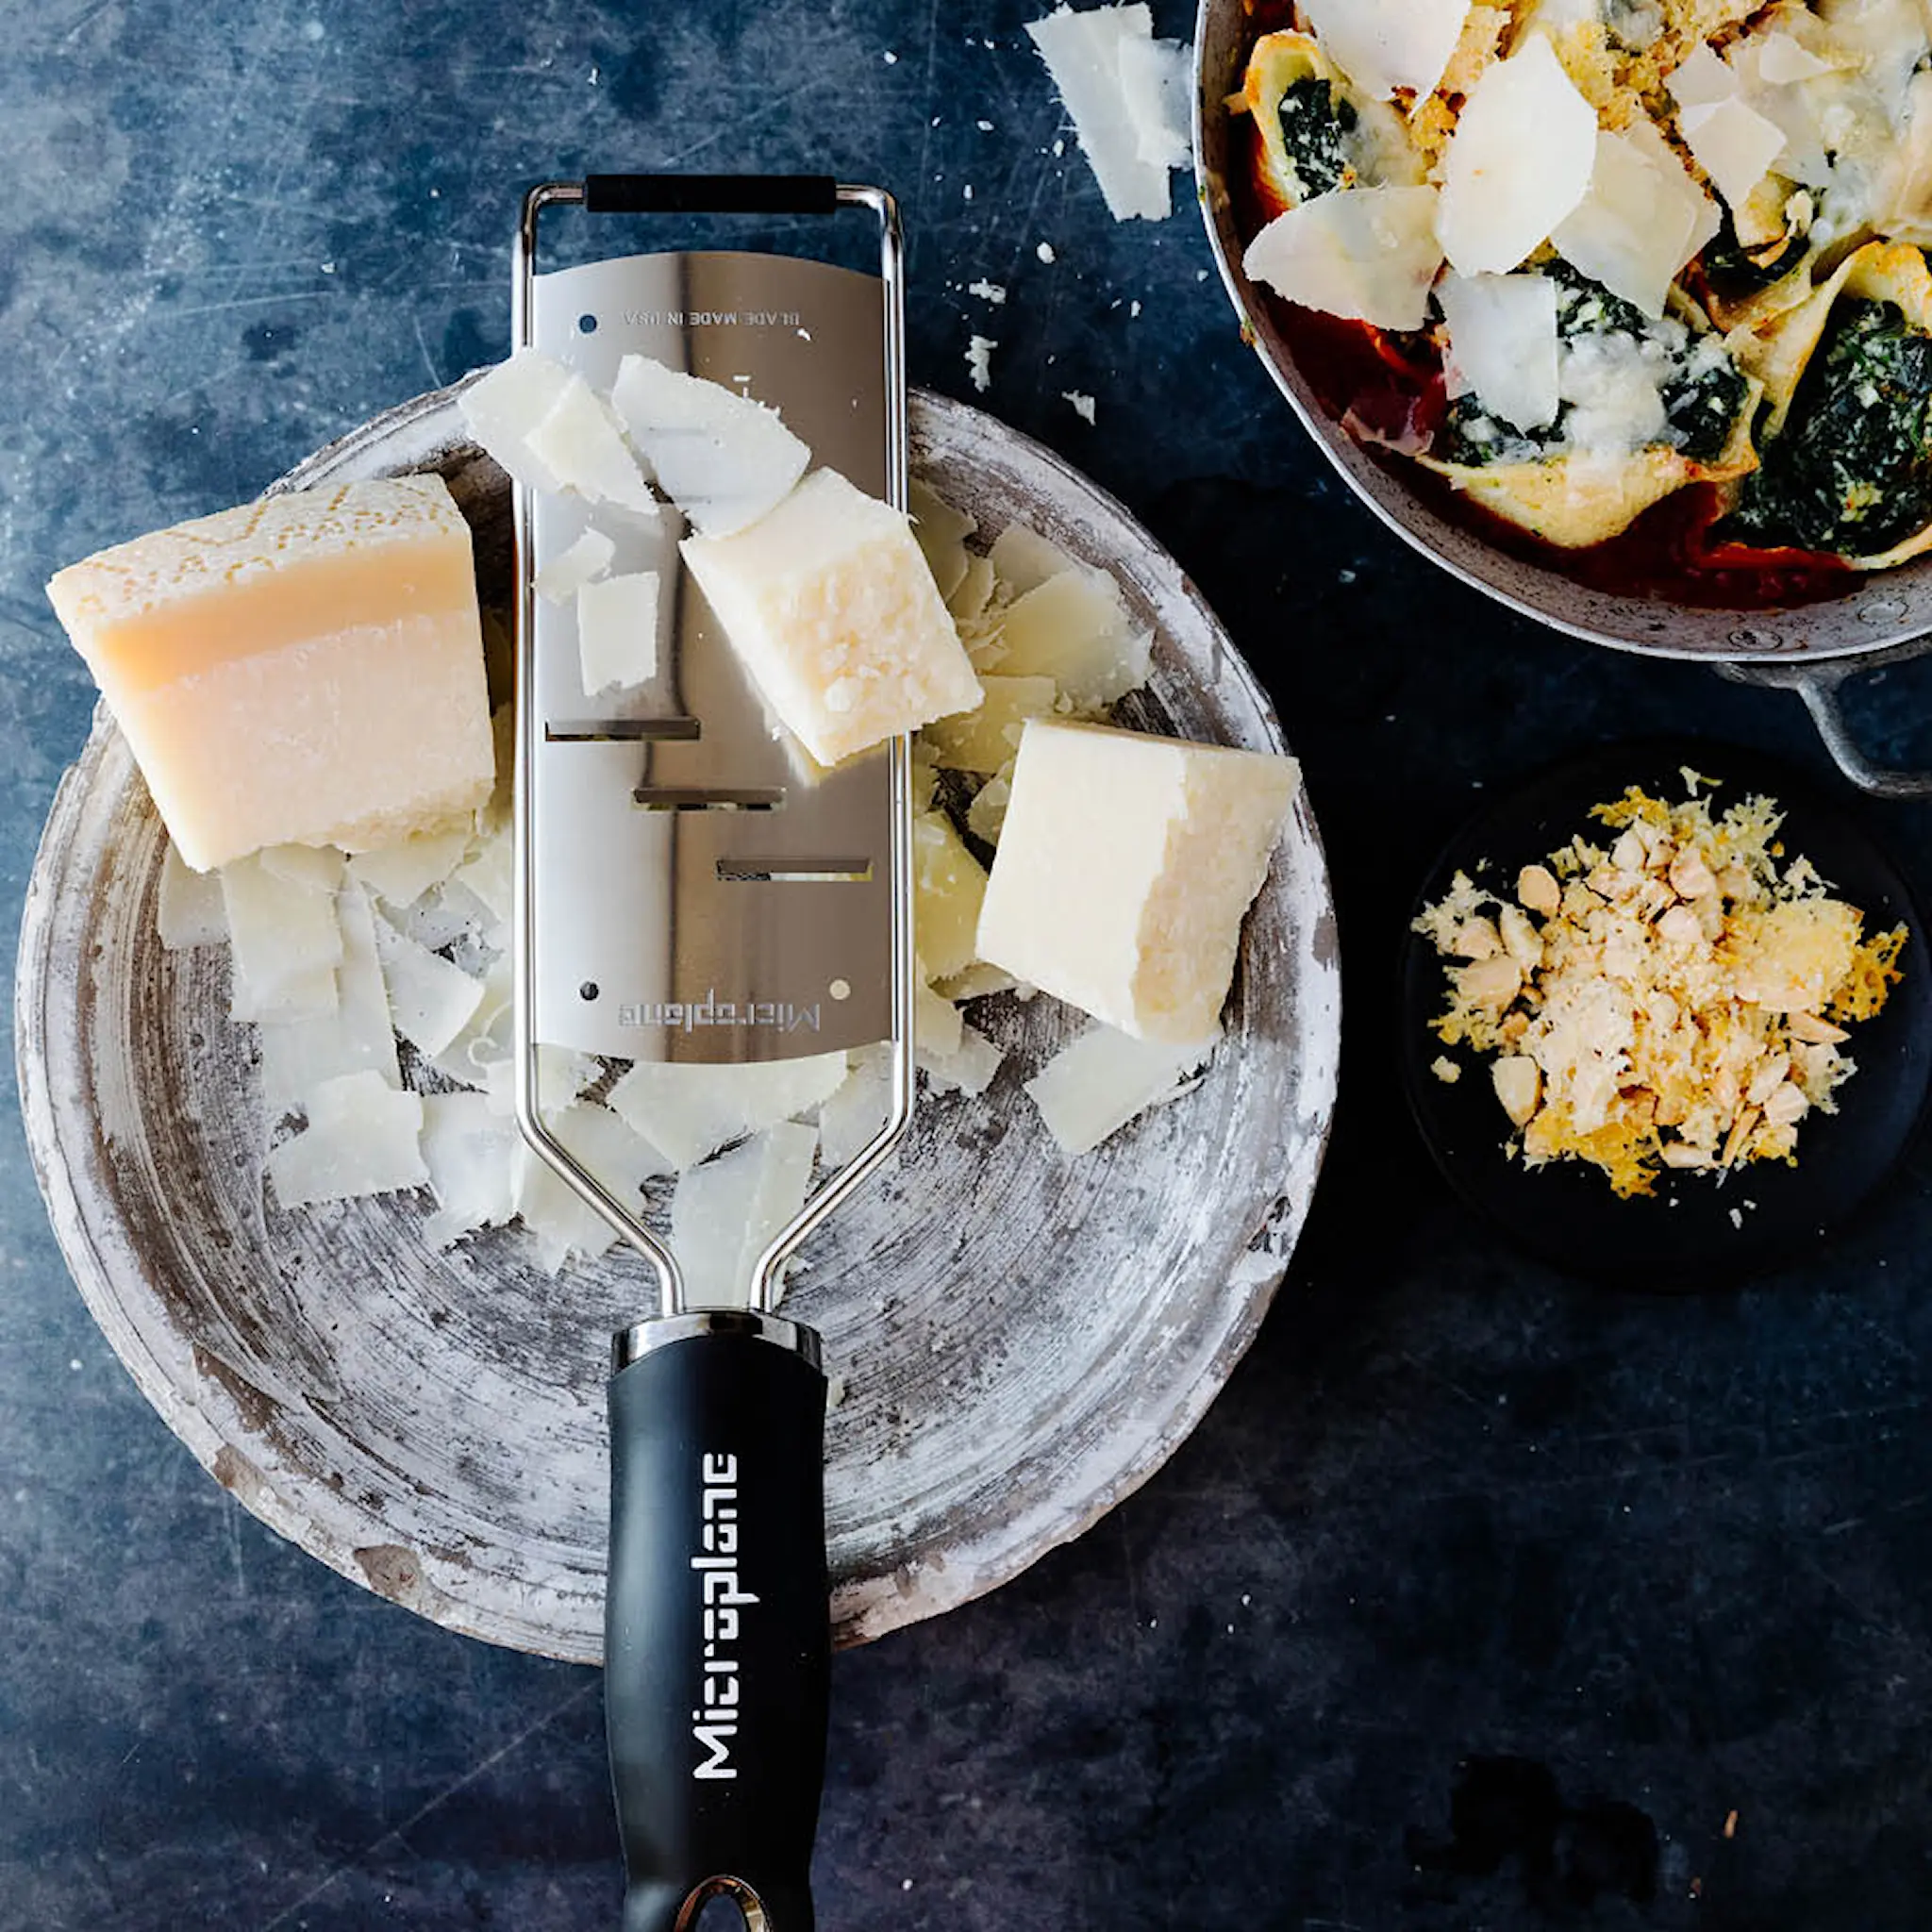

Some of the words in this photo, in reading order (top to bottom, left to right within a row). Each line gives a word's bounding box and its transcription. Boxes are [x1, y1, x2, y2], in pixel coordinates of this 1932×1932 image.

[621, 310, 660, 326] USA
[667, 310, 684, 326] IN
[690, 310, 738, 326] MADE
[743, 310, 800, 326] BLADE
[618, 988, 821, 1033] Microplane
[690, 1452, 760, 1779] Microplane
